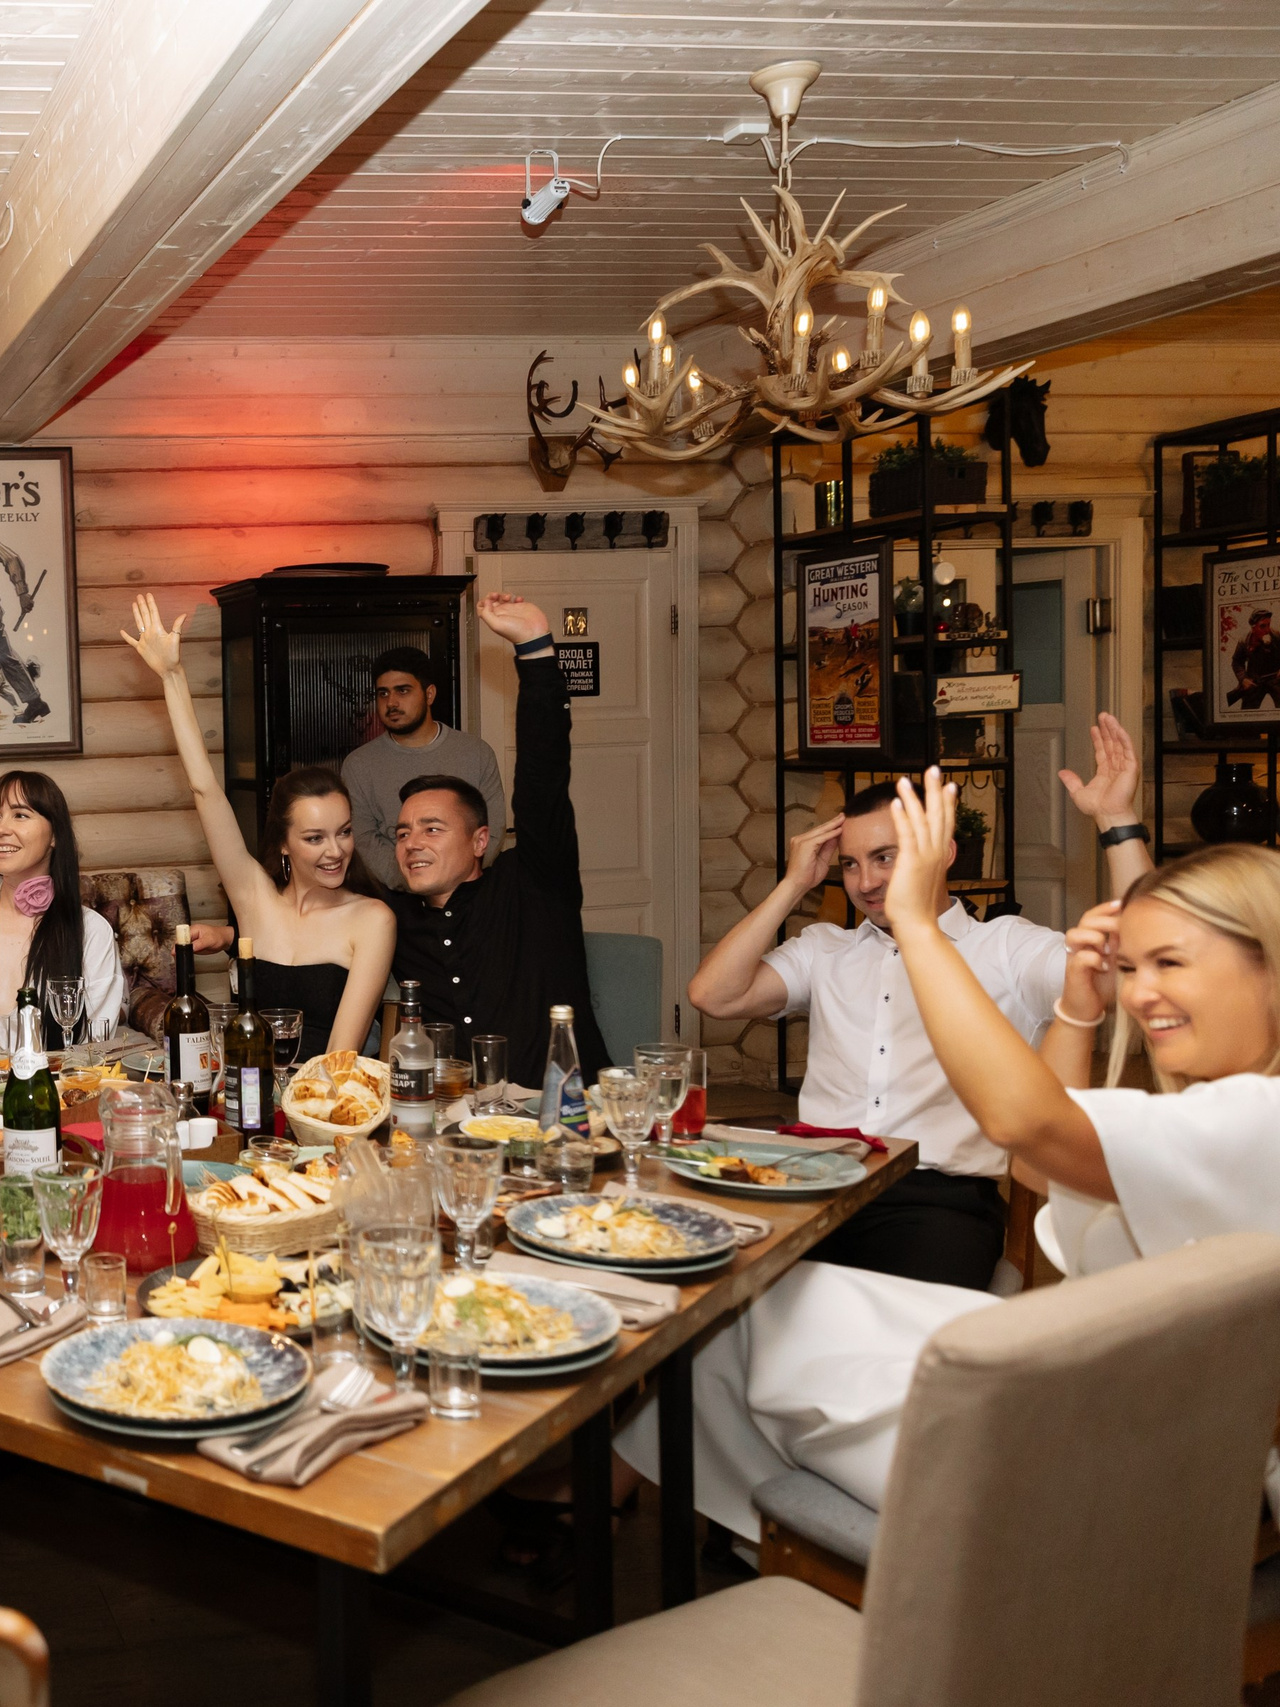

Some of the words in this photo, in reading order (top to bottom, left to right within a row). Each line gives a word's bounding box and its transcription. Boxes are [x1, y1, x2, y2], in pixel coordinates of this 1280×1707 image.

[810, 567, 835, 581] GREAT
[836, 560, 878, 577] WESTERN
[1218, 571, 1240, 584] The
[813, 582, 868, 607] HUNTING
[558, 649, 584, 660] ВХОД
[586, 648, 593, 658] В
[558, 659, 594, 670] ТУАЛЕТ
